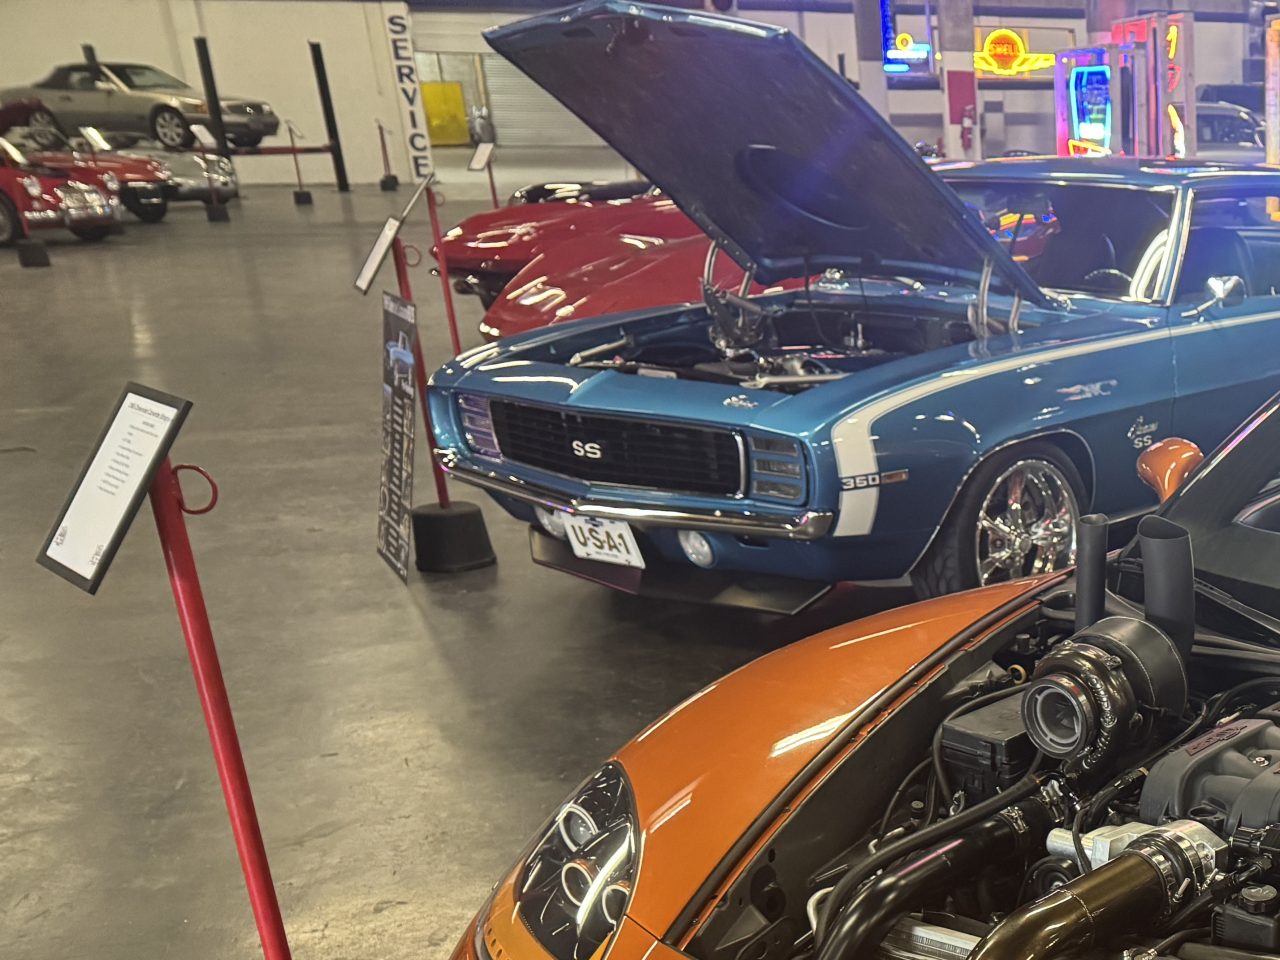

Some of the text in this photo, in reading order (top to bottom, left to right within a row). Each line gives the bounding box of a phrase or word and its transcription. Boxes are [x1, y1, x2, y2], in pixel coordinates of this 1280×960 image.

[387, 15, 430, 179] SERVICE
[572, 440, 602, 459] SS
[1133, 435, 1153, 449] SS
[841, 474, 880, 489] 350
